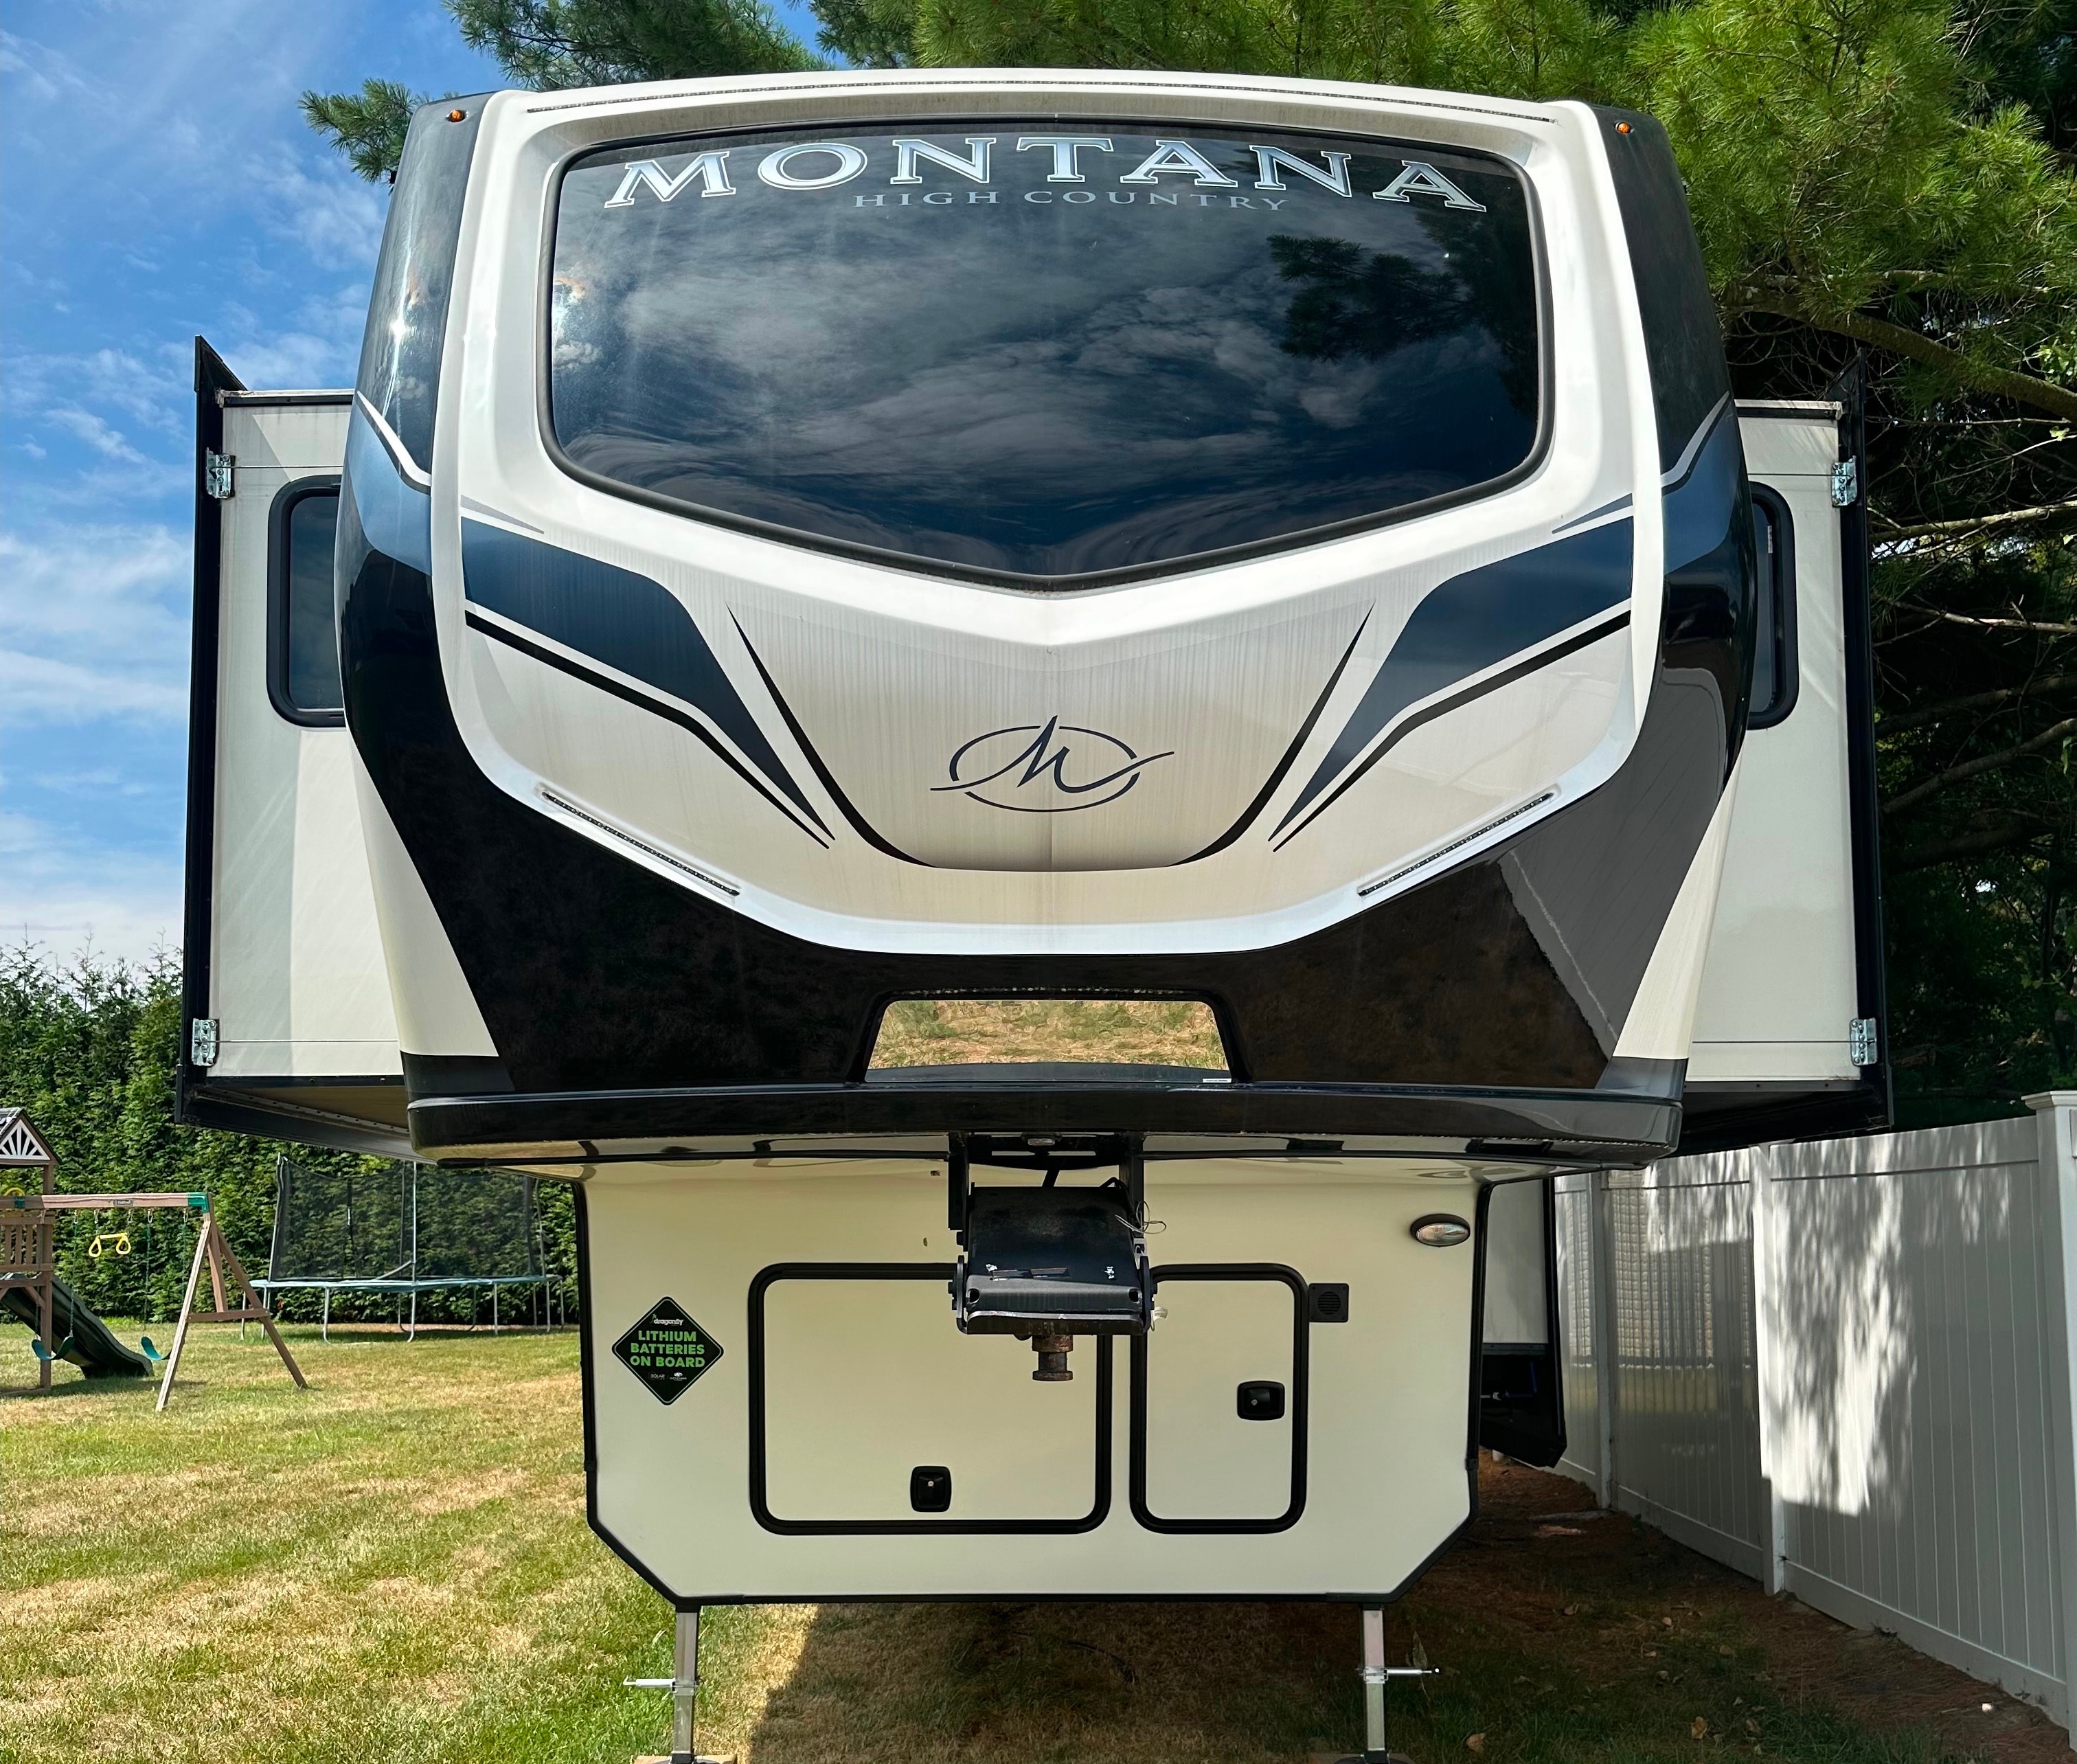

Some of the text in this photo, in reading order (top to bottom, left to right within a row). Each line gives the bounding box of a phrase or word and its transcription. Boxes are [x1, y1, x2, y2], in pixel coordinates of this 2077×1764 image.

[604, 137, 1487, 213] MONTANA
[853, 190, 1290, 211] HIGH COUNTRY
[638, 1330, 696, 1342] LITHIUM
[631, 1343, 705, 1355] BATTERIES
[630, 1355, 705, 1368] ON BOARD
